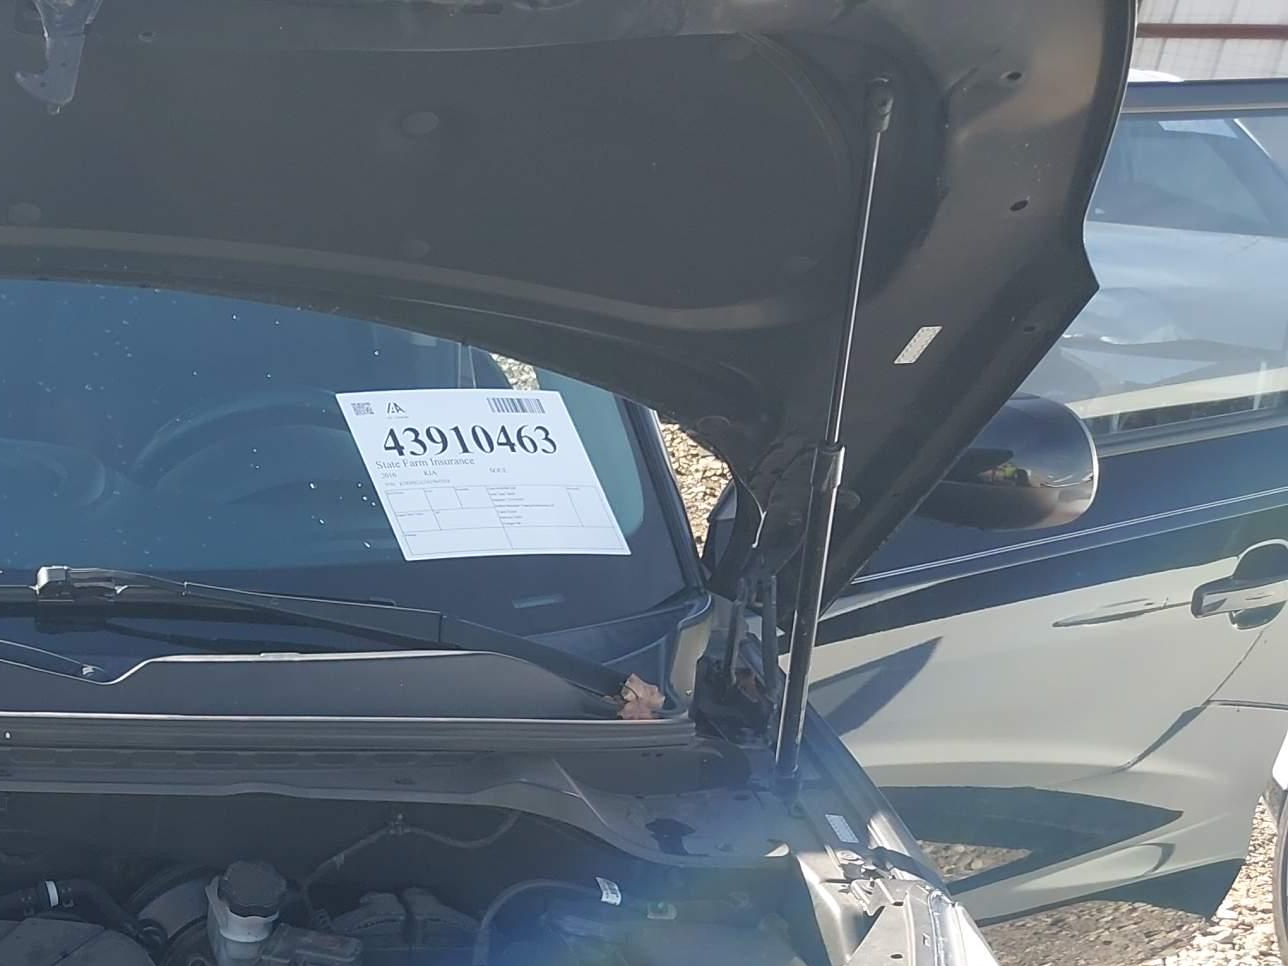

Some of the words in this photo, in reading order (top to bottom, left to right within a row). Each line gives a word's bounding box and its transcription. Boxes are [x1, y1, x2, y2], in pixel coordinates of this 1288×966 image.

[383, 424, 557, 457] 43910463
[375, 460, 400, 470] State
[402, 459, 429, 468] Farm
[430, 457, 475, 467] Insurance
